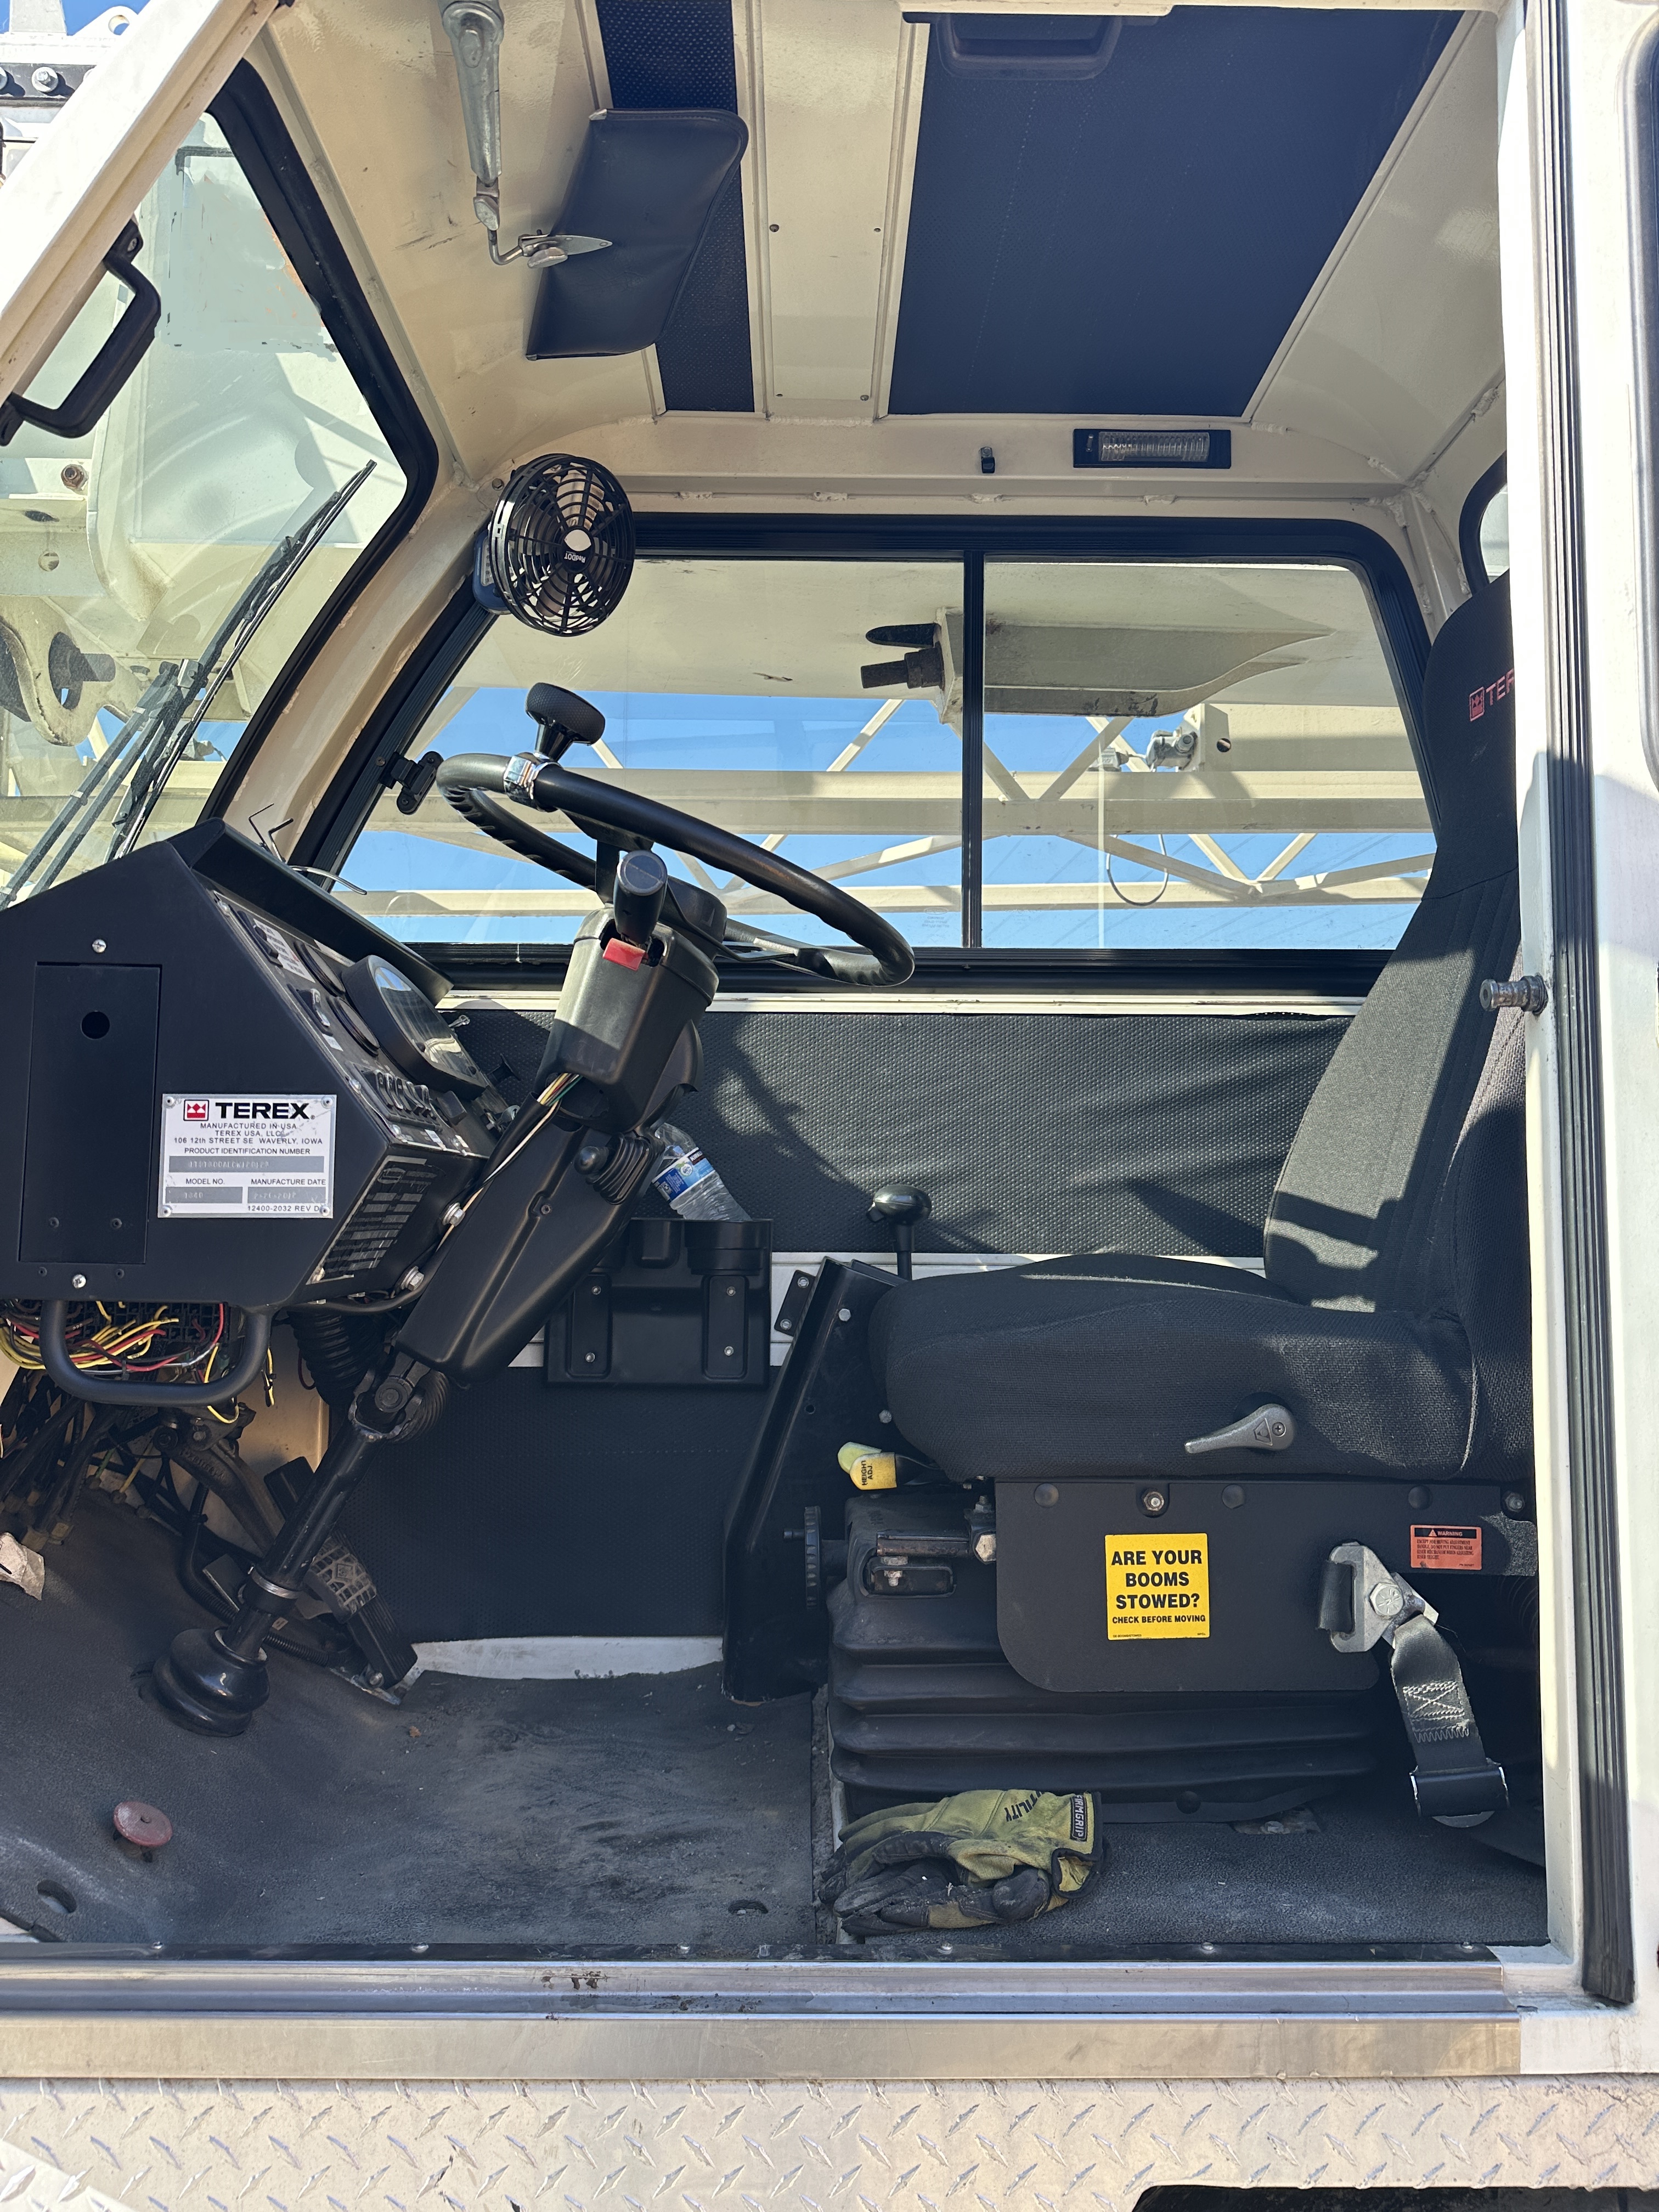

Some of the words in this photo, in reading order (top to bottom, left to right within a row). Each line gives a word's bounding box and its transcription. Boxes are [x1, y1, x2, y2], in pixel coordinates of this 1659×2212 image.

[215, 1102, 310, 1119] TEREX
[1111, 1550, 1147, 1566] ARE
[1151, 1550, 1203, 1565] YOUR
[1125, 1572, 1189, 1587] BOOMS
[1115, 1593, 1200, 1610] STOWED?
